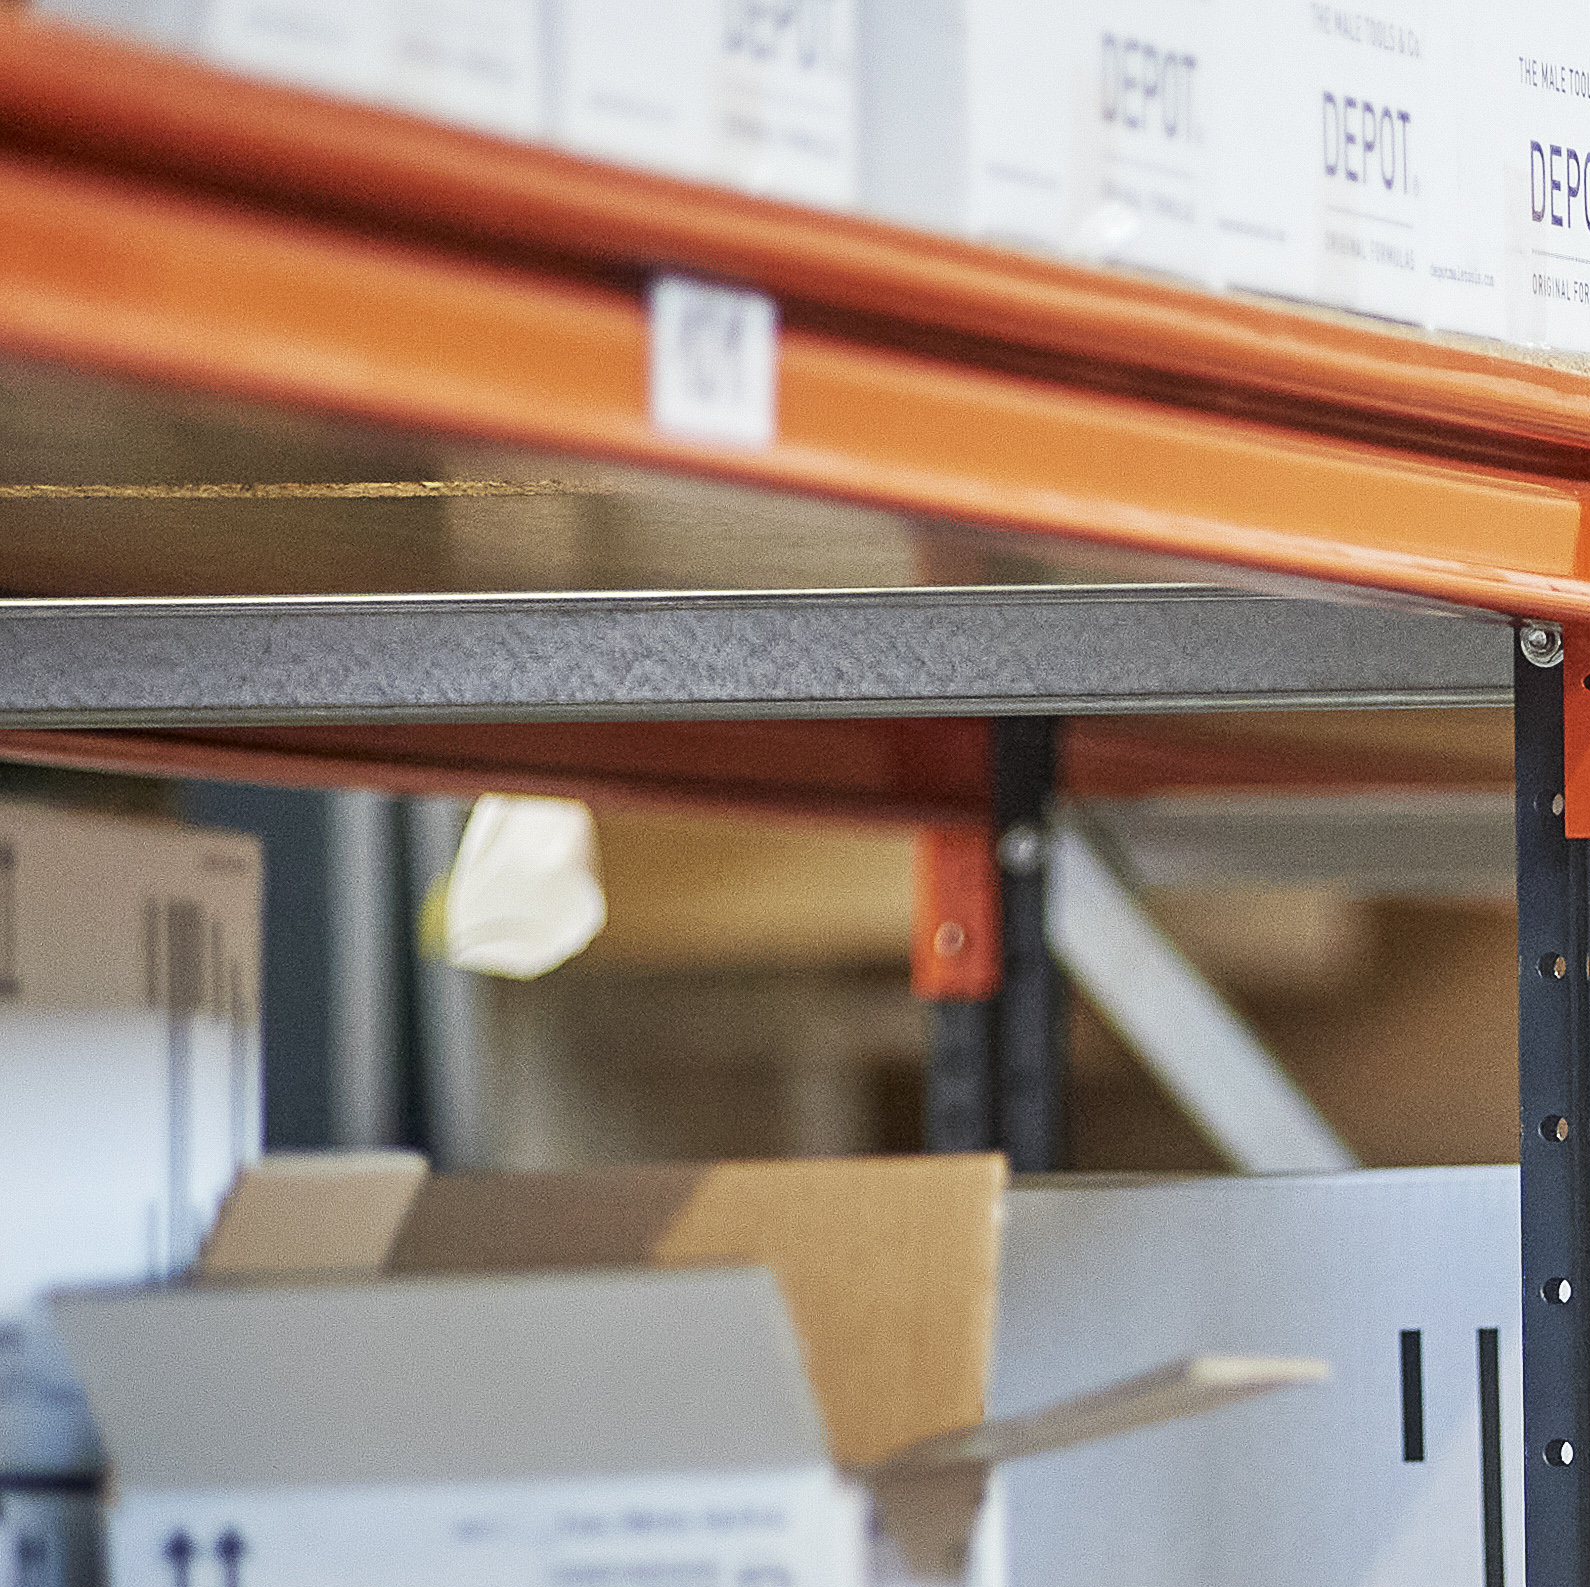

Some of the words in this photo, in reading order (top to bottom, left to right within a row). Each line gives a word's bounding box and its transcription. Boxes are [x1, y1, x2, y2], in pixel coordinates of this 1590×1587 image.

[1519, 56, 1538, 88] THE
[1541, 62, 1567, 95] MALE
[1322, 90, 1413, 196] DEPOT
[1532, 273, 1572, 301] ORIGINAL
